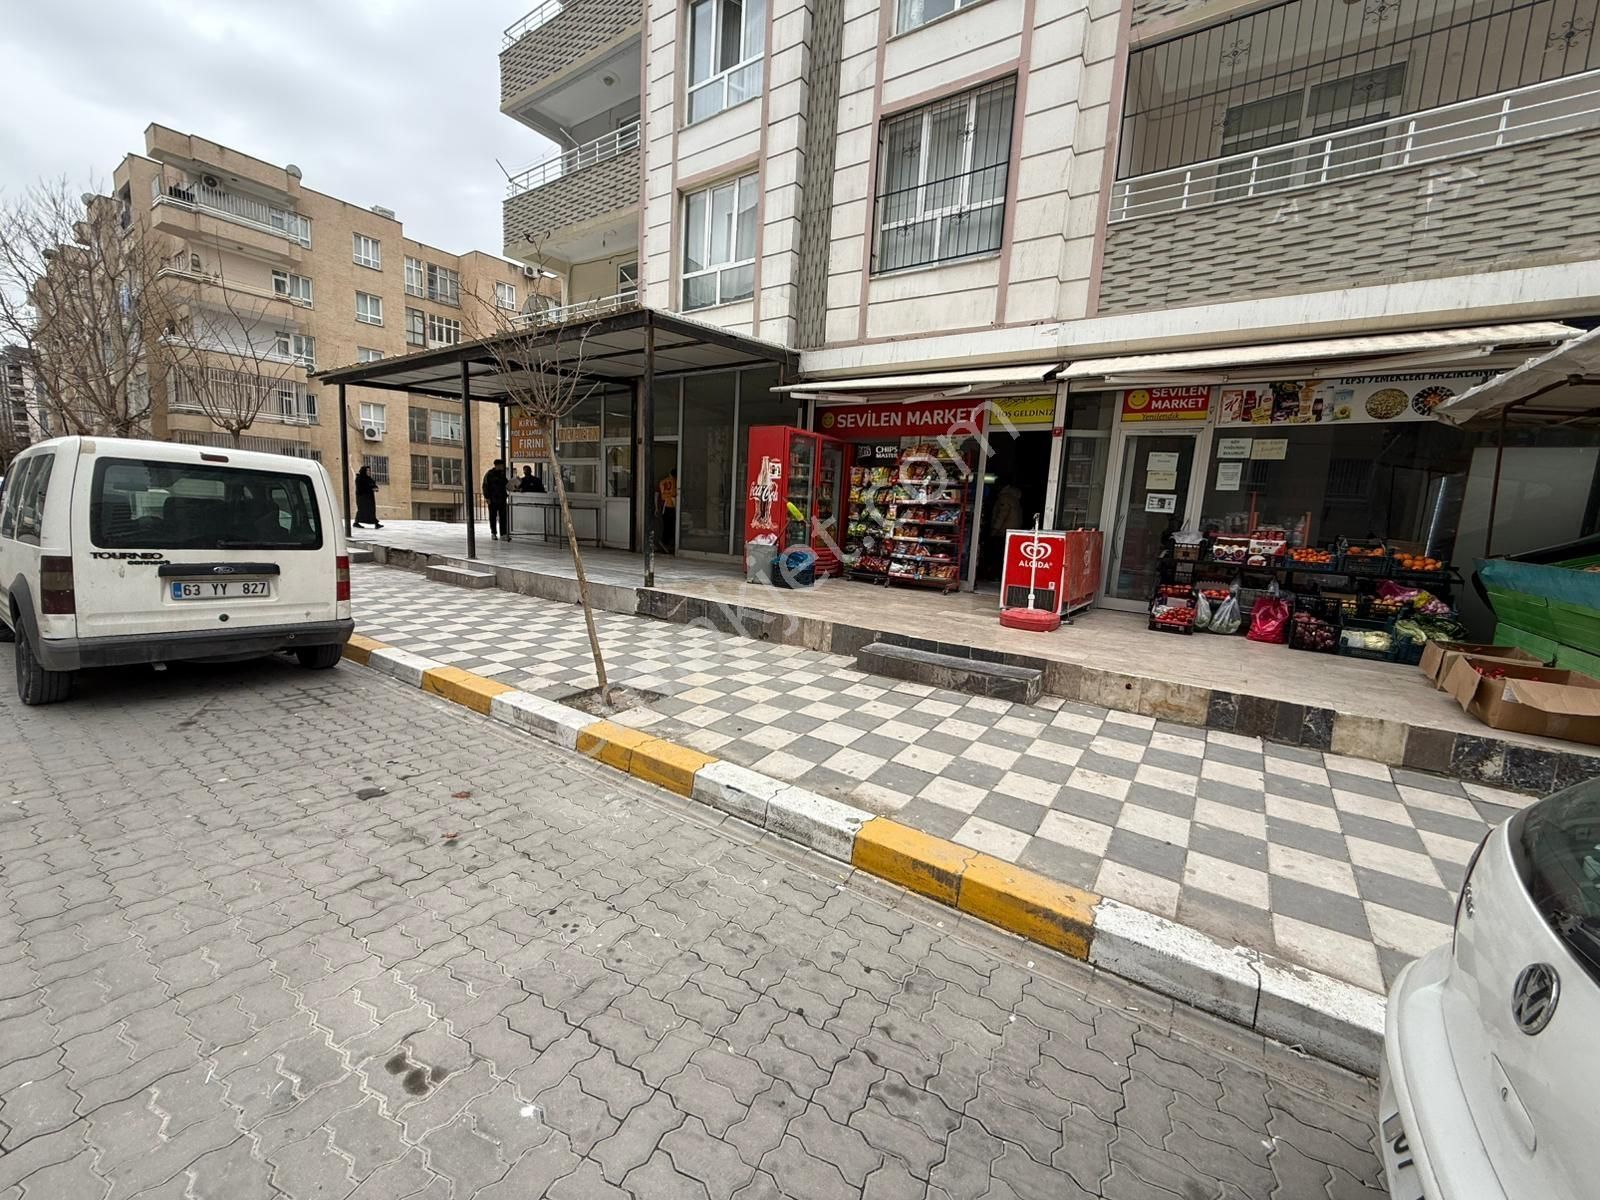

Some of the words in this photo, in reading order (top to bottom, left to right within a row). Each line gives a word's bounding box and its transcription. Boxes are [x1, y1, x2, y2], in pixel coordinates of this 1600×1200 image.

[1151, 398, 1205, 410] MARKET
[837, 410, 902, 428] SEVİLEN
[906, 407, 979, 426] MARKET
[519, 438, 544, 449] FIRINI
[90, 552, 164, 560] TOURNEO
[183, 584, 201, 596] 63
[211, 583, 228, 596] YY
[242, 582, 266, 595] 827
